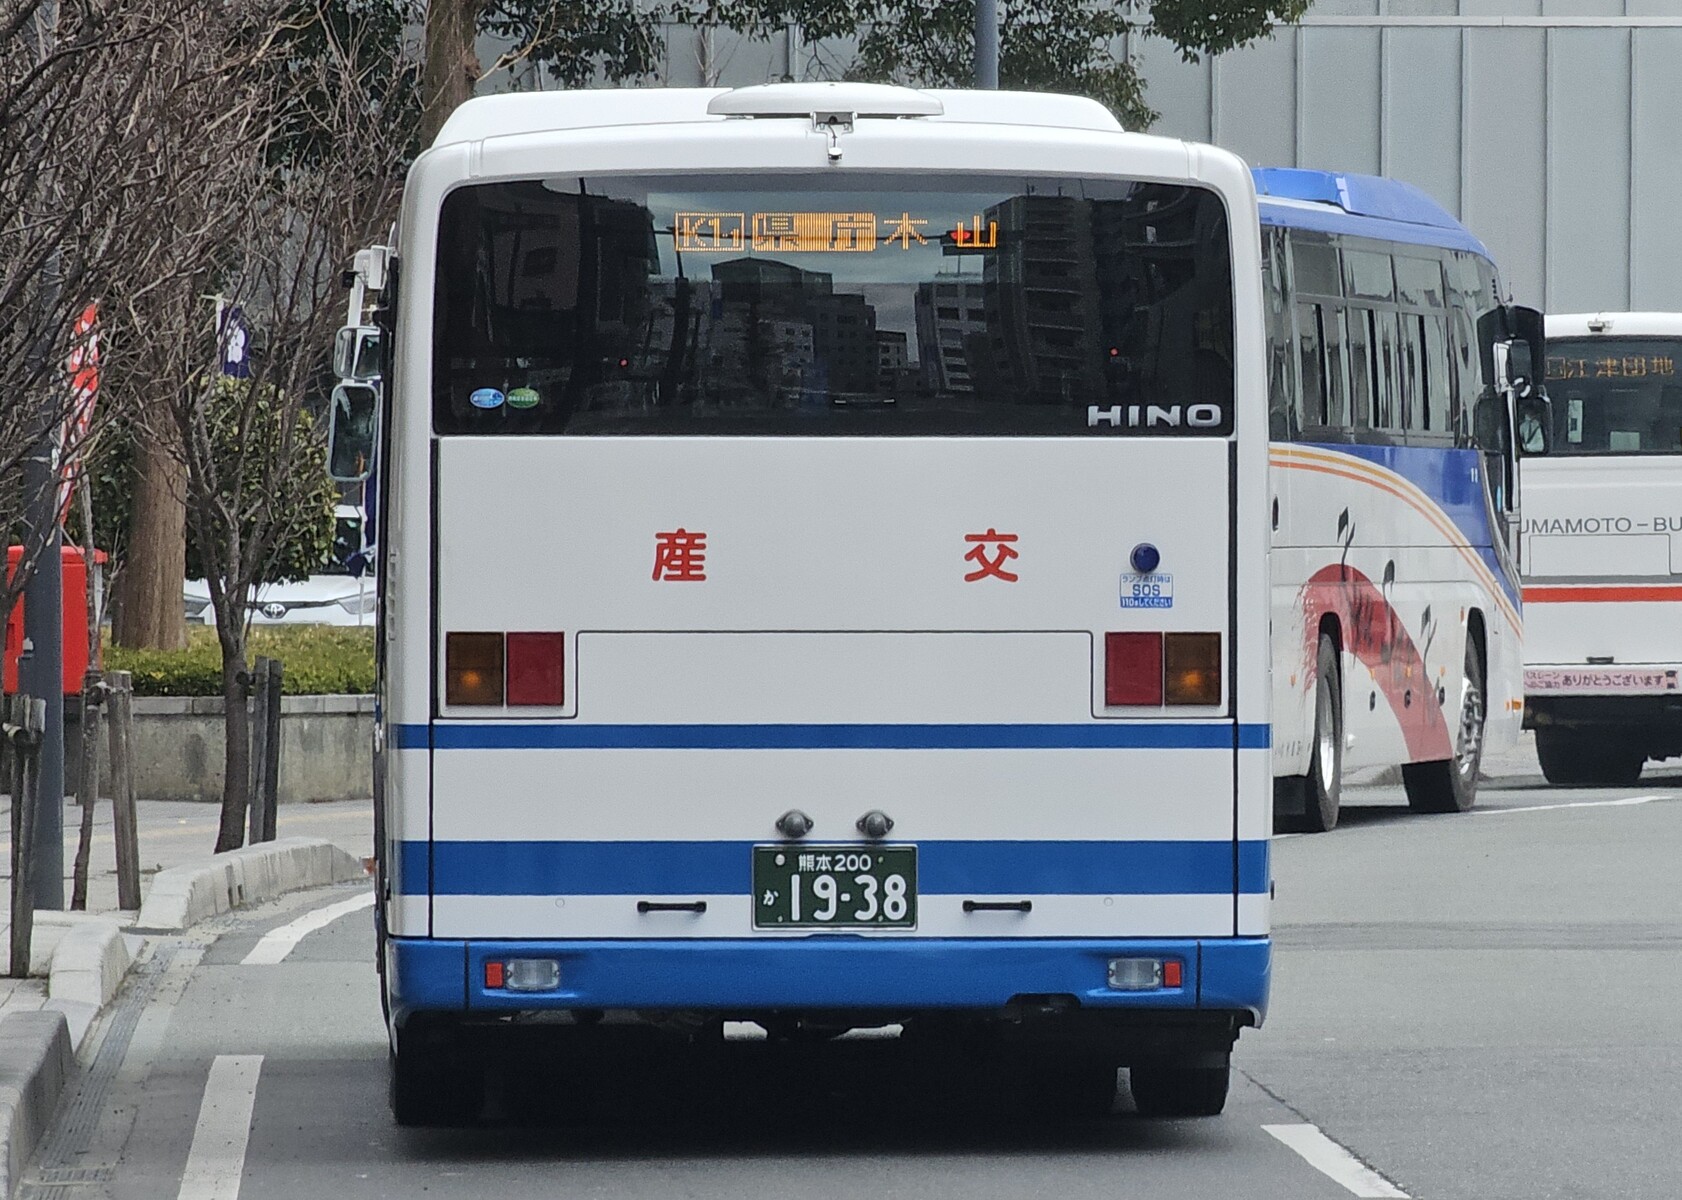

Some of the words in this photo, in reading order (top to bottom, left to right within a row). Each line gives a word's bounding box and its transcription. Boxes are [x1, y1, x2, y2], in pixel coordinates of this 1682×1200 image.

[1087, 403, 1222, 427] HINO
[652, 528, 707, 582] 産
[964, 528, 1019, 582] 交
[1132, 584, 1161, 596] SOS
[1562, 674, 1663, 687] ありがとうございます
[762, 889, 780, 906] か
[791, 874, 907, 921] 19-38
